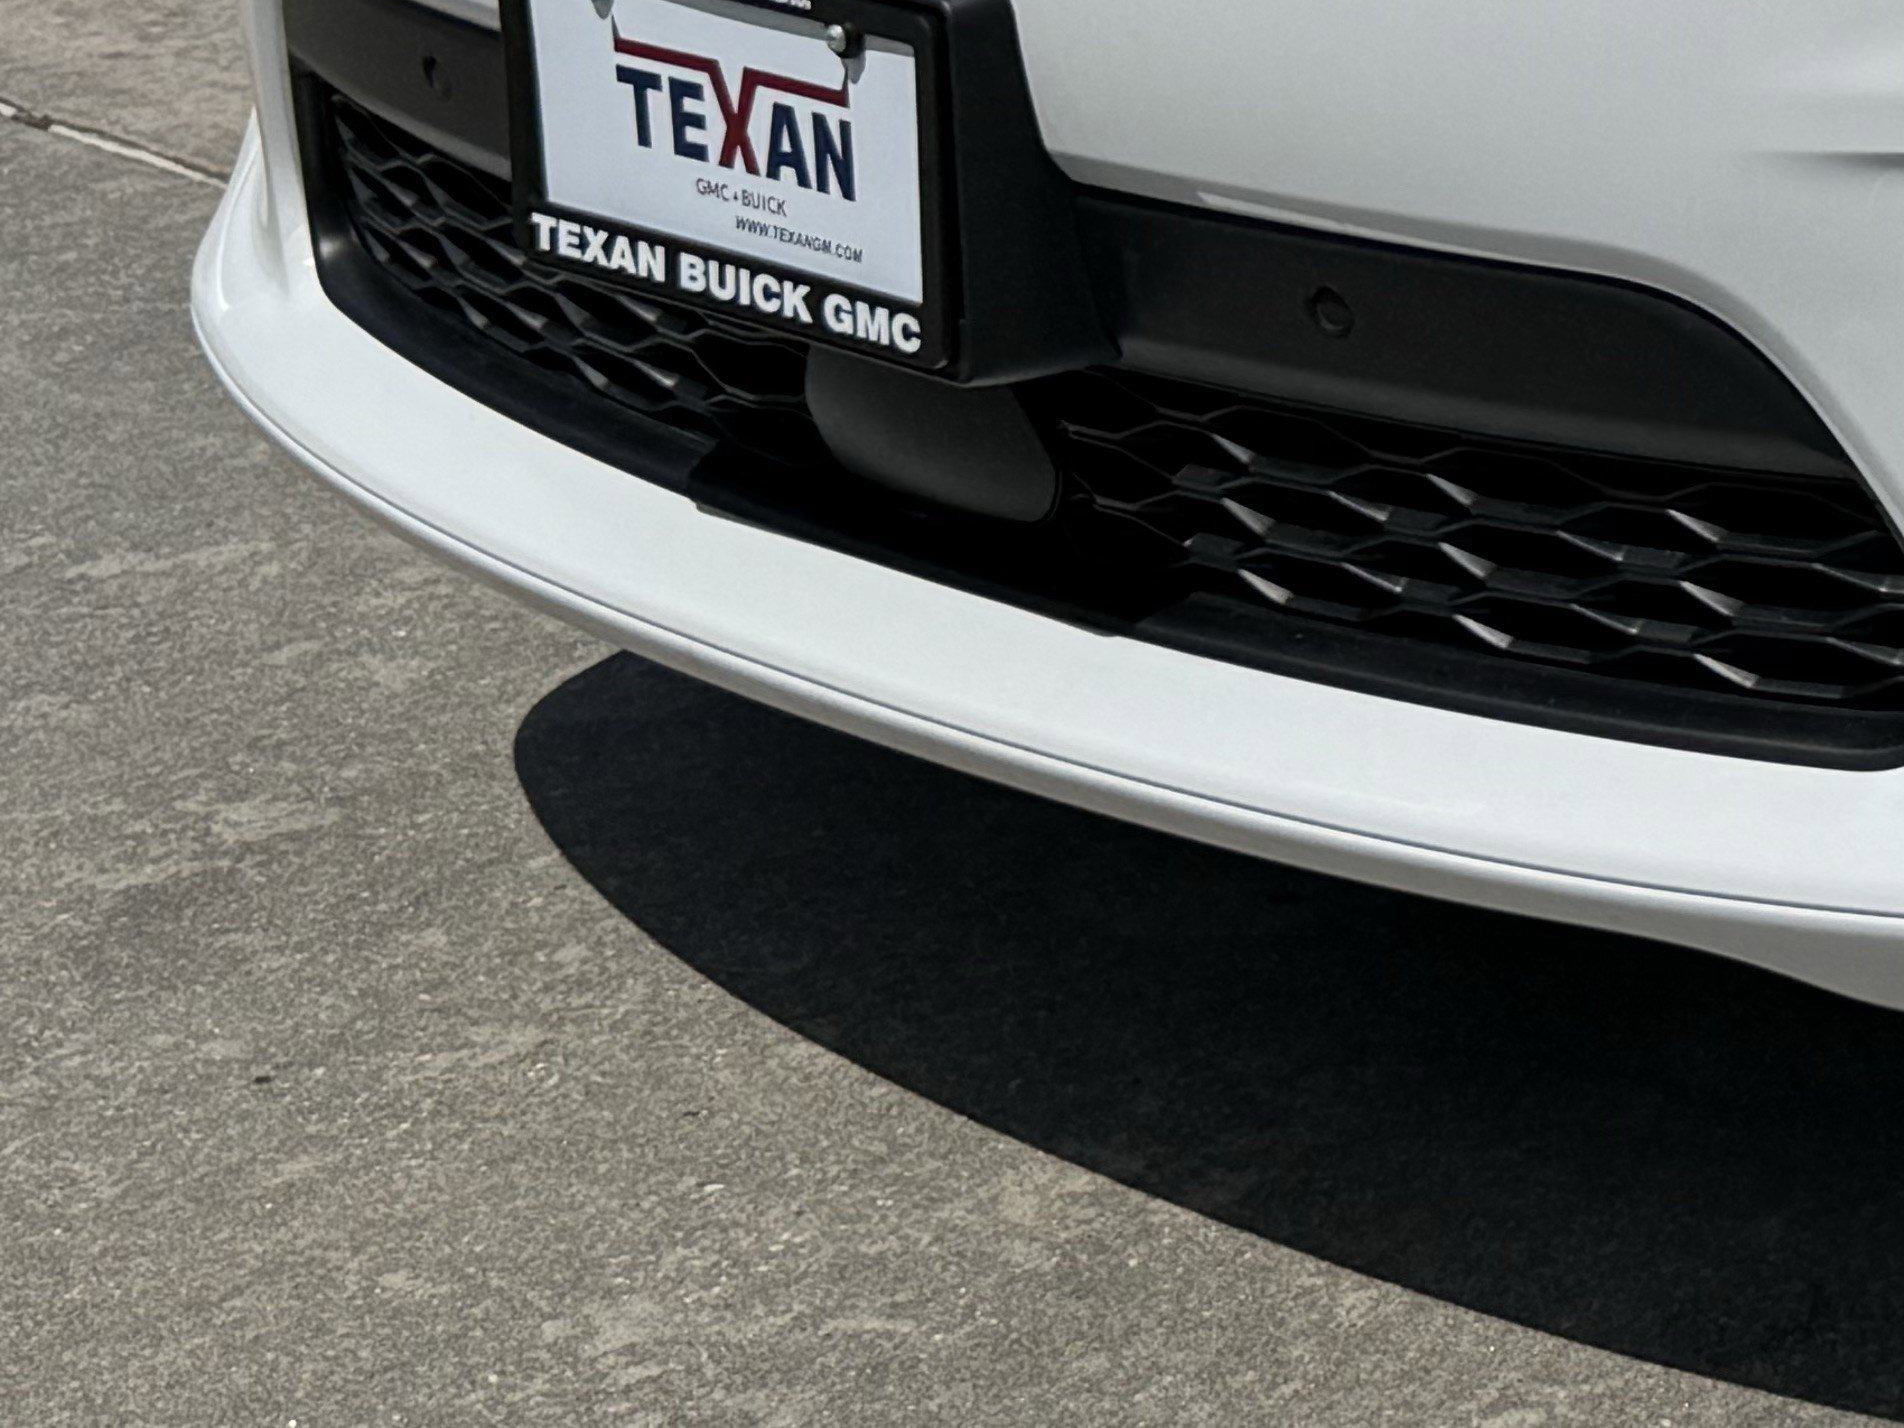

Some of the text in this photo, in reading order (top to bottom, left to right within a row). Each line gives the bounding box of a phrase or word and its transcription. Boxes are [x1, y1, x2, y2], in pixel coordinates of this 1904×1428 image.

[614, 39, 858, 203] TEXAN
[696, 177, 787, 217] GMC BUICK
[735, 215, 864, 263] WWW.TEXANGM.COM
[530, 210, 922, 353] TEXAN BUICK GMC
